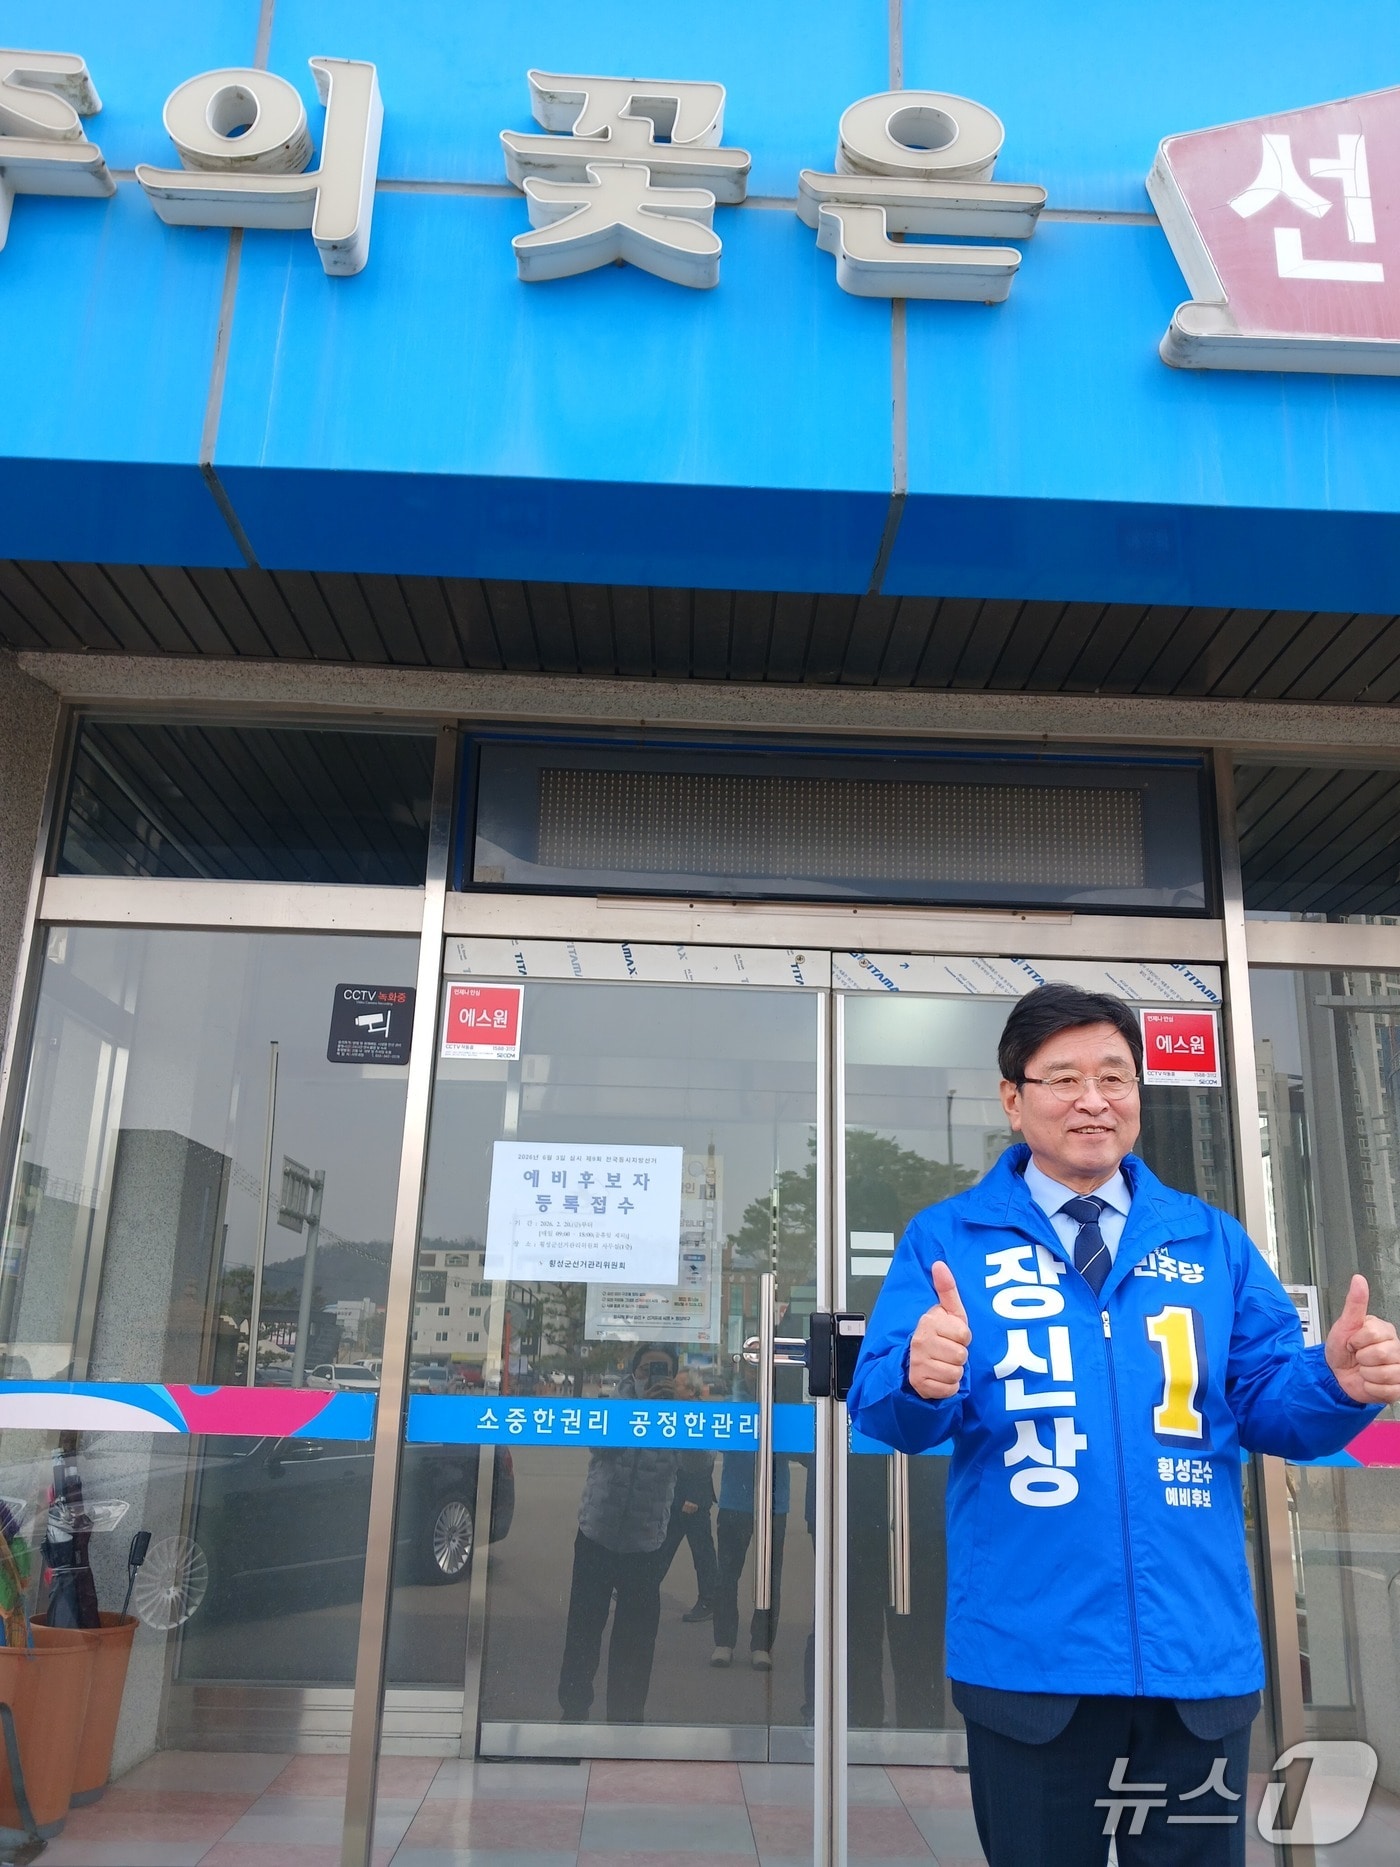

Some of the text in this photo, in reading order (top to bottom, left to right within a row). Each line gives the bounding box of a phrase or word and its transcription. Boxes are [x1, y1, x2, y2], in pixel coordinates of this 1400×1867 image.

[500, 69, 1048, 298] 꽃은
[1227, 133, 1384, 283] 선
[343, 989, 407, 1003] CCTV 녹화중
[470, 989, 480, 997] 안심
[459, 1008, 508, 1029] 에스원
[1156, 1034, 1205, 1055] 에스원
[518, 1153, 539, 1161] 2026년
[523, 1169, 650, 1191] 예비후보자
[549, 1259, 626, 1270] 횡성군선거관리위원회
[1146, 1304, 1205, 1440] 1
[476, 1407, 759, 1440] 소중한권리 공정한관리
[1157, 1456, 1213, 1484] 횡성군수
[1165, 1486, 1213, 1509] 예비후보
